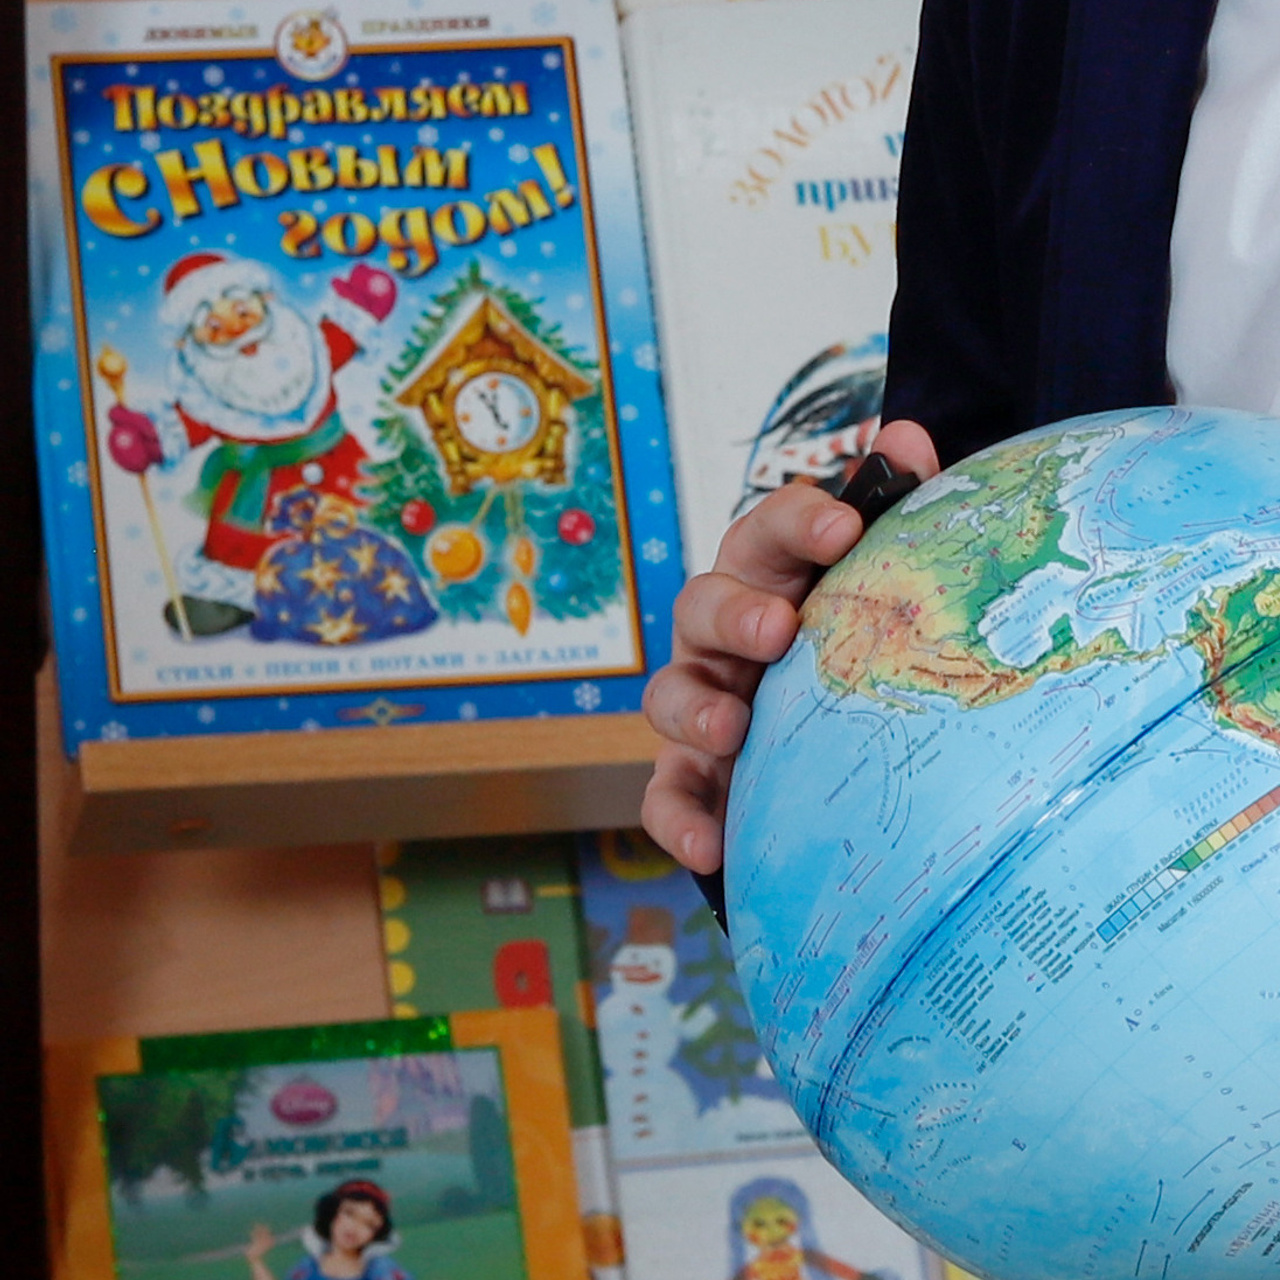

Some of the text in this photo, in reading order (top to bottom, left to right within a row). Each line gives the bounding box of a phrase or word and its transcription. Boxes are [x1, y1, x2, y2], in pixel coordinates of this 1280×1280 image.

[103, 80, 531, 140] Поздравляем
[81, 138, 470, 239] С Новым
[278, 143, 576, 277] годом!
[156, 666, 234, 684] СТИХИ
[264, 659, 341, 678] ПЕСНИ
[370, 652, 464, 673] НОТАМИ
[493, 645, 600, 667] ЗАГАДКИ
[1103, 892, 1126, 914] ШКАЛА
[1126, 868, 1153, 895] ГЛУБИН
[1159, 843, 1185, 867] ВЫСОТ
[1192, 818, 1220, 841] МЕТРАХ
[1240, 852, 1269, 875] Южный
[1156, 905, 1189, 934] Масштаб
